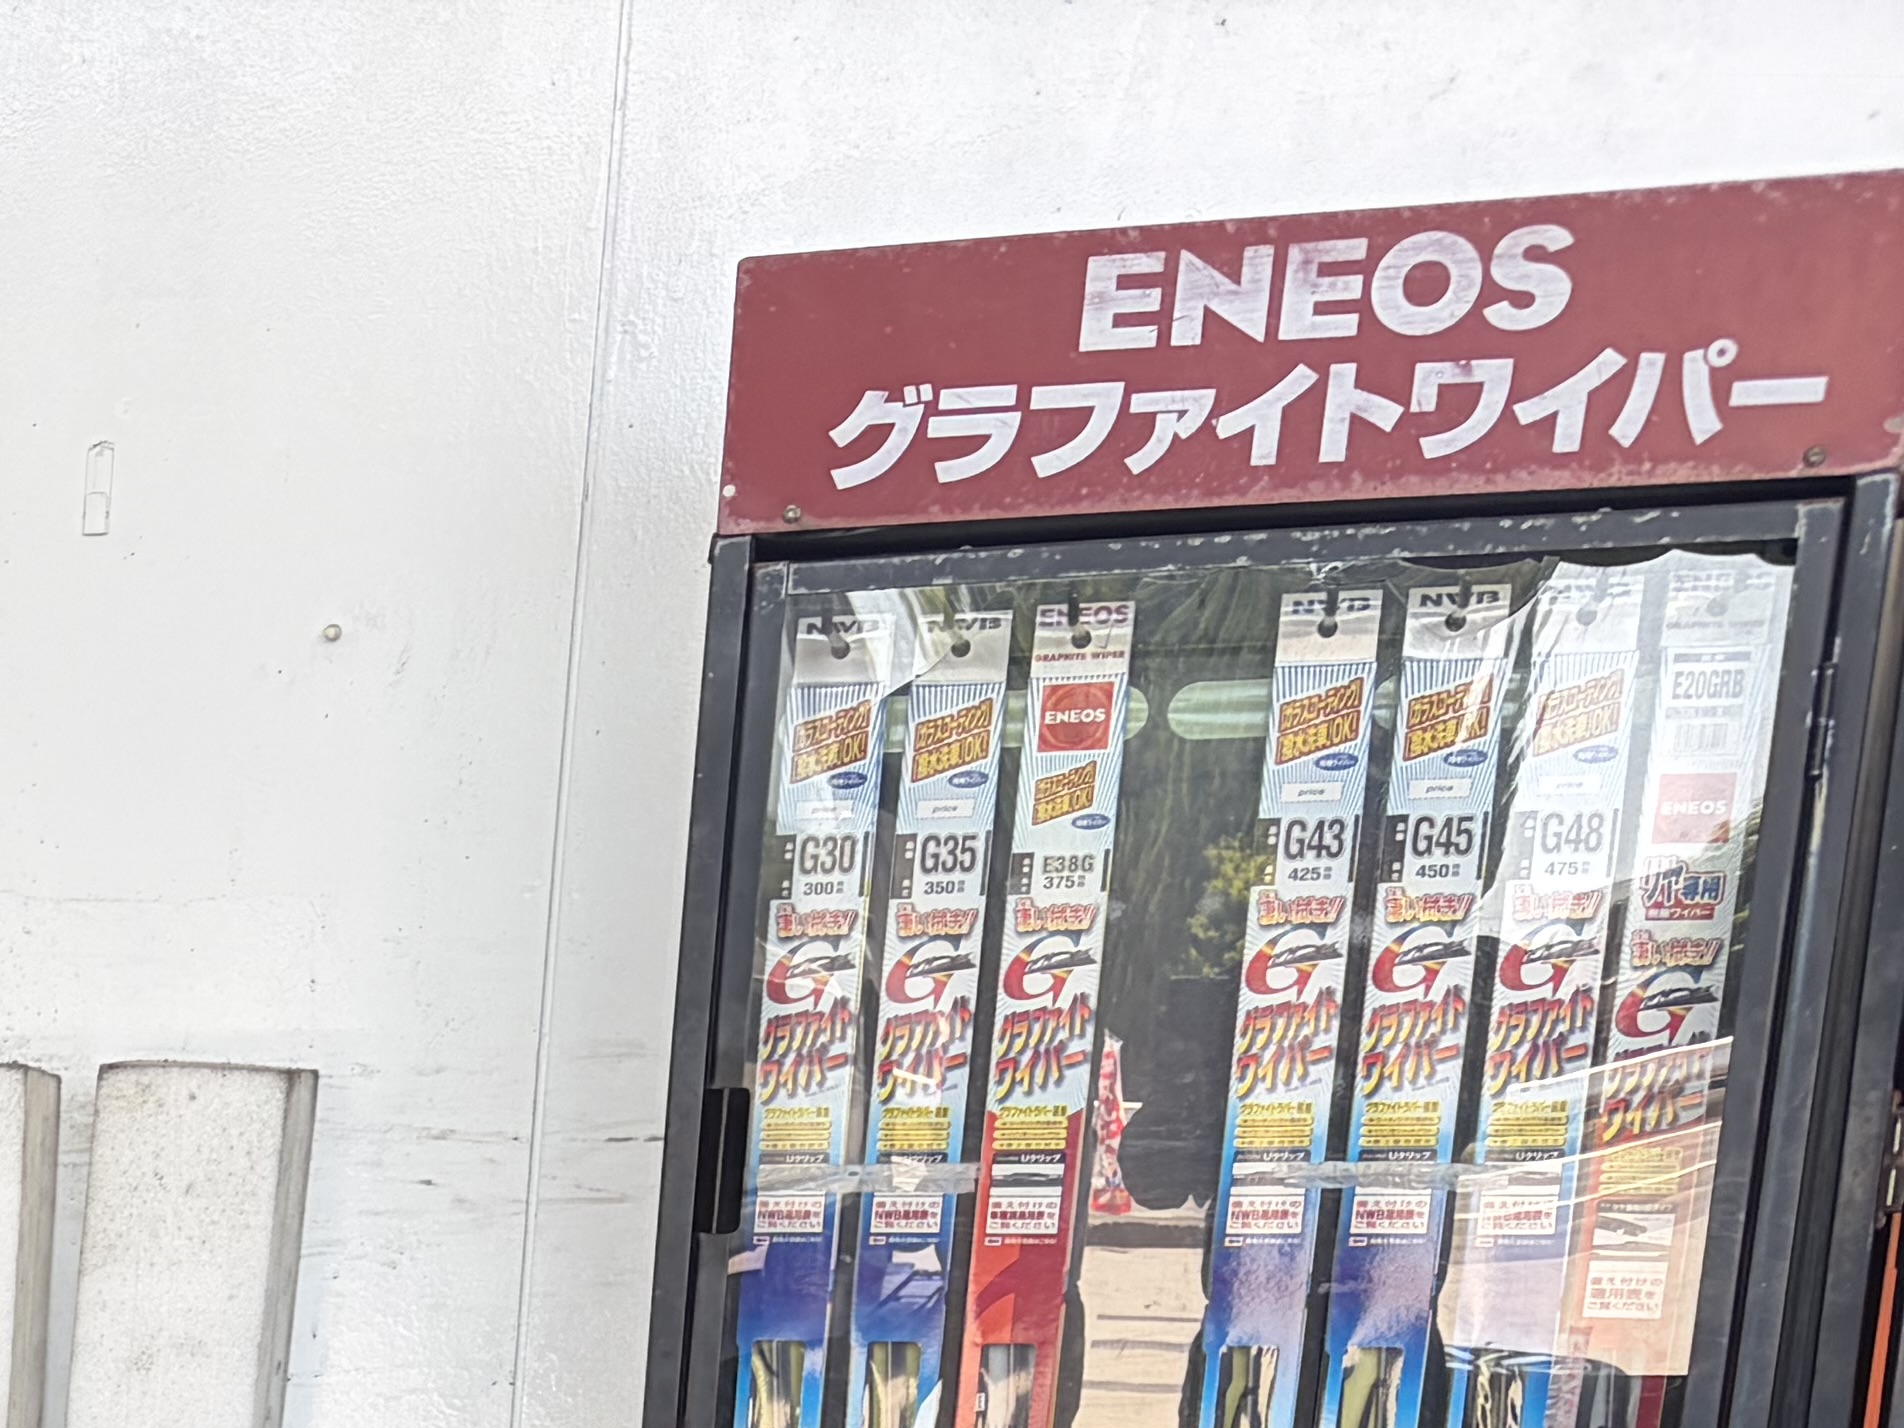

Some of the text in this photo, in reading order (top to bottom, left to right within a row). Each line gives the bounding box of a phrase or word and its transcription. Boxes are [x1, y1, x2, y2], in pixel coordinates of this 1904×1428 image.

[1078, 224, 1575, 353] ENEOS
[828, 339, 1829, 490] グラファイトワイパー
[1090, 650, 1126, 662] WIPER
[1672, 669, 1743, 700] E20GRB
[1044, 707, 1107, 725] ENEOS
[1660, 799, 1728, 816] ENEOS
[1284, 818, 1345, 860] G43
[1411, 815, 1474, 858] G45
[1540, 812, 1604, 855] G48
[799, 834, 856, 876] G30
[920, 834, 978, 876] G35
[1041, 856, 1094, 874] E38G
[1288, 867, 1321, 882] 425
[1415, 864, 1449, 879] 450
[1545, 861, 1578, 876] 475
[804, 881, 834, 896] 300
[924, 881, 956, 895] 350
[1043, 875, 1076, 889] 375
[997, 992, 1091, 1058] グラファイト
[1239, 983, 1339, 1051] グラファイト
[1362, 983, 1467, 1051] グラファイト
[995, 1042, 1088, 1103] ワイパー
[1235, 1038, 1334, 1098] ワイパー
[1360, 1035, 1460, 1097] ワイパー
[1485, 1031, 1587, 1097] ワイパー
